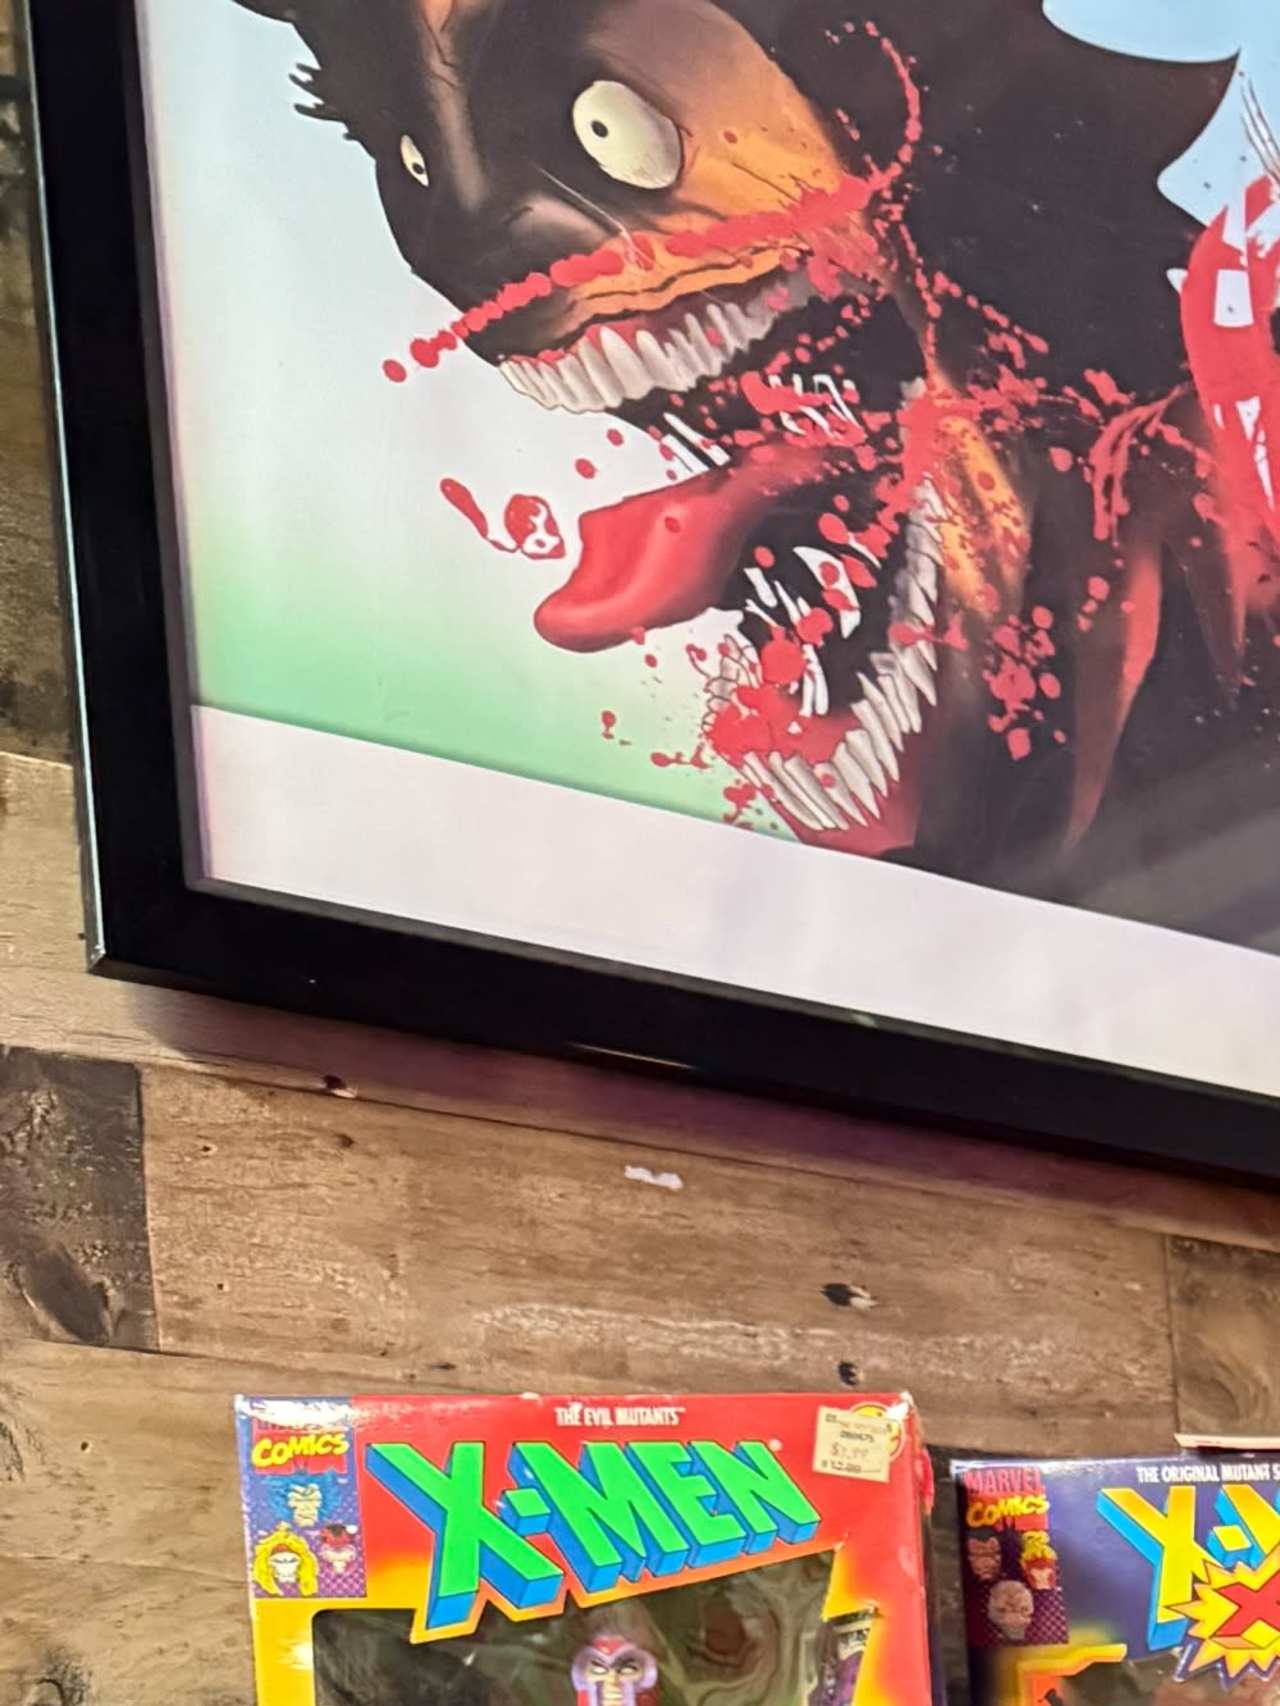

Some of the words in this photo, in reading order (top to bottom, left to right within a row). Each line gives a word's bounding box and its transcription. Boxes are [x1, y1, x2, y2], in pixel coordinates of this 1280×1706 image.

[555, 1402, 581, 1426] THE
[583, 1407, 612, 1426] EVIL
[616, 1406, 680, 1426] MUTANTS
[252, 1433, 350, 1468] COMICS
[963, 1468, 1043, 1494] MARVEL
[1136, 1465, 1159, 1483] THE
[1162, 1464, 1220, 1482] ORIGINAL
[1221, 1463, 1270, 1481] MUTANT
[966, 1494, 1051, 1527] COMICS
[365, 1440, 821, 1630] X-MEN
